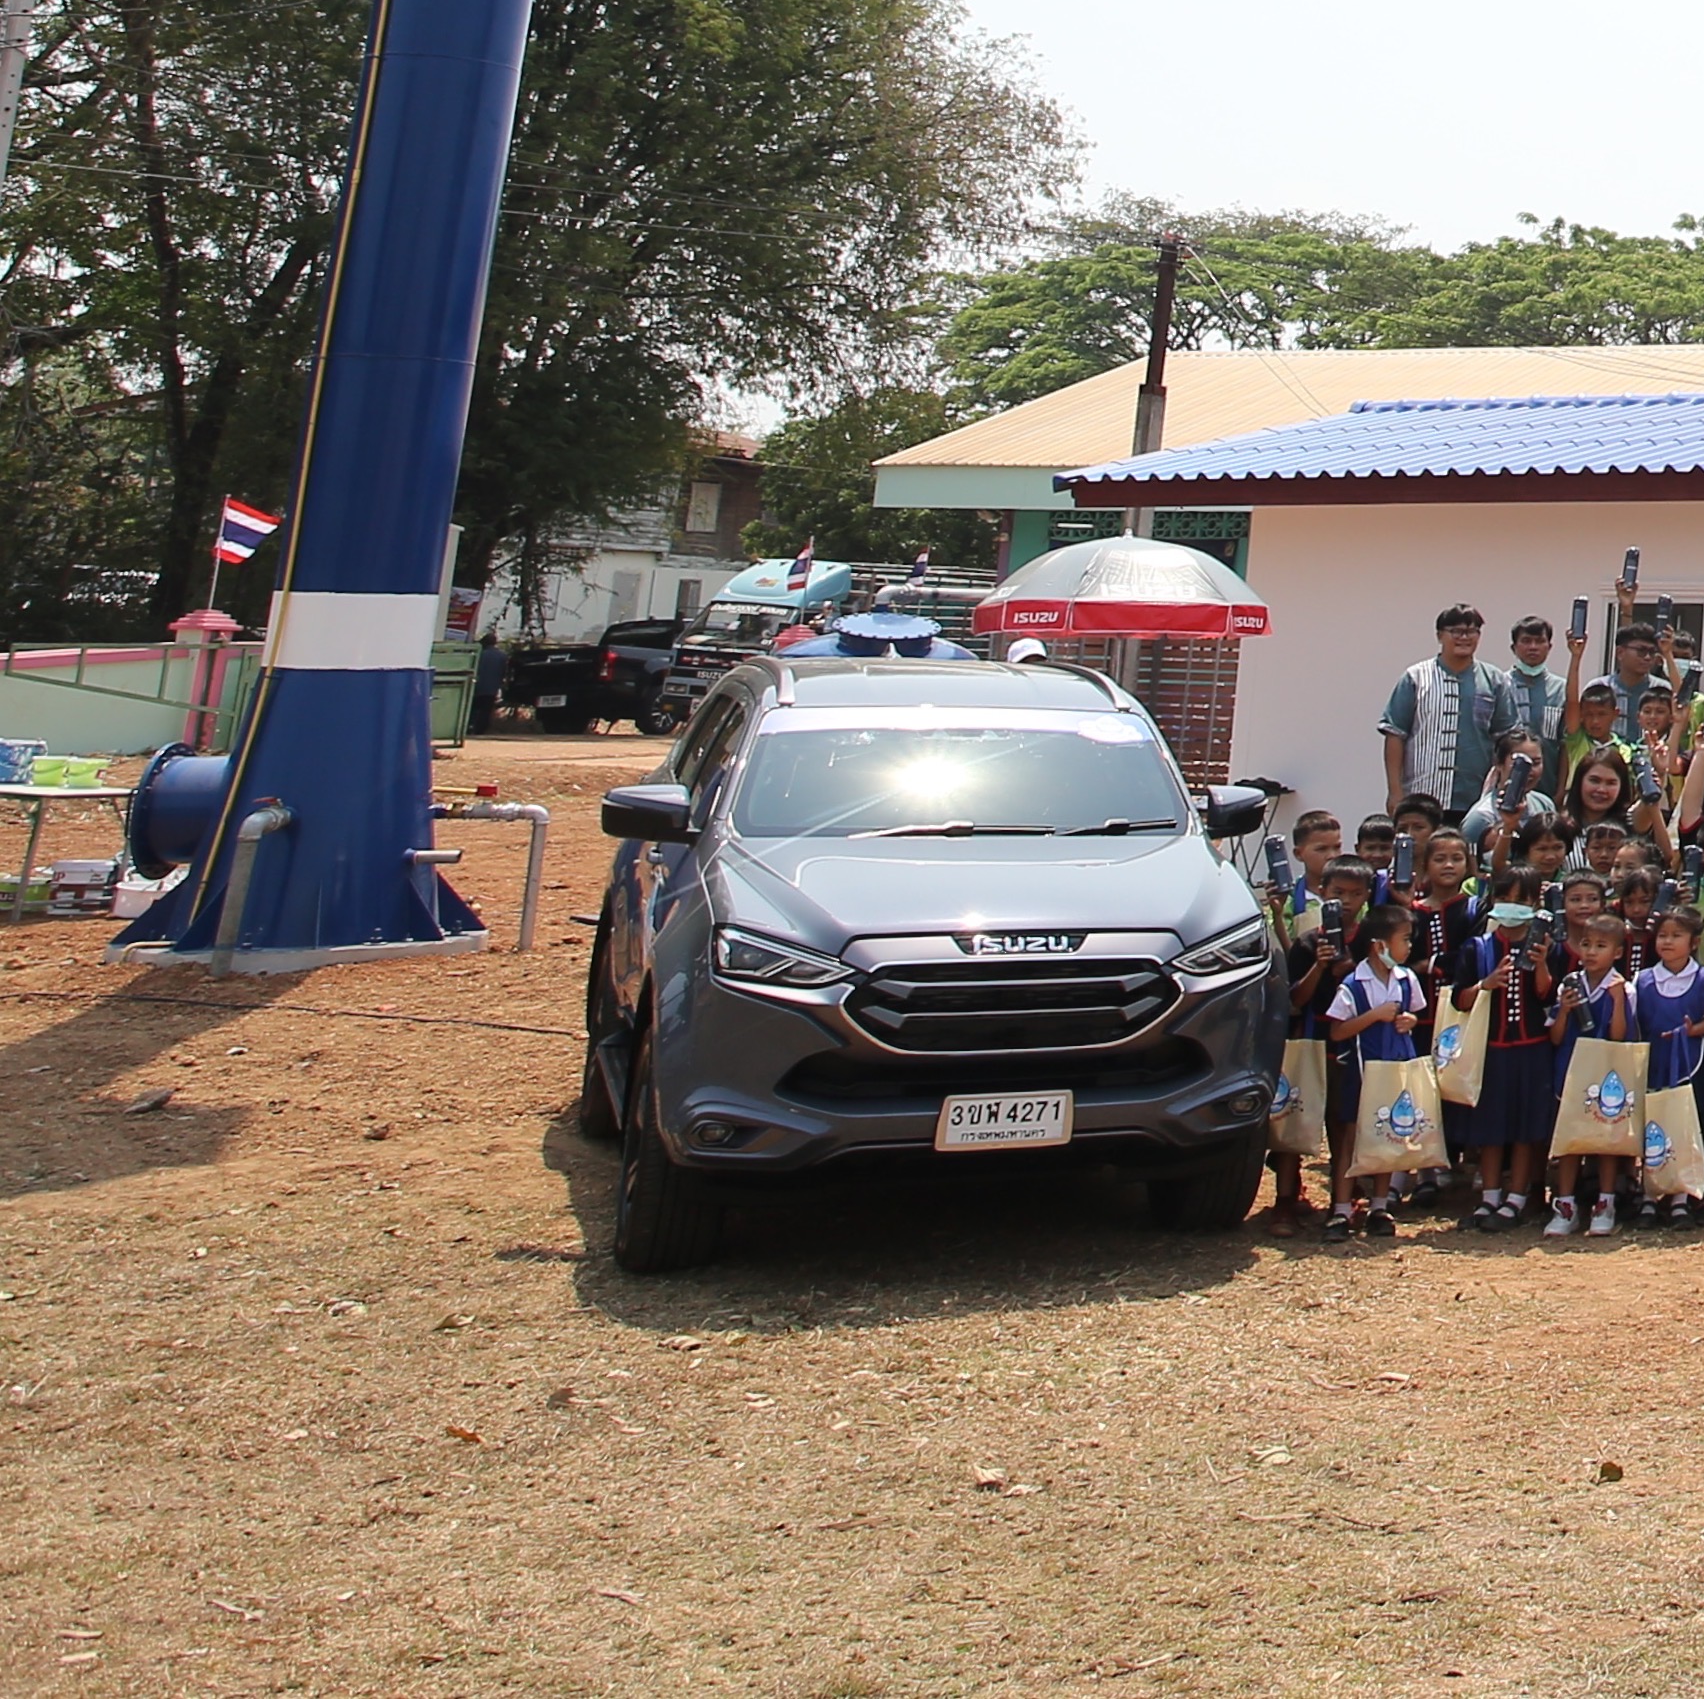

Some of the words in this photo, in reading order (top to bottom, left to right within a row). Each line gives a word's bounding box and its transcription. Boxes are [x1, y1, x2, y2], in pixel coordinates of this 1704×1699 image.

[1012, 611, 1060, 624] ISUZU
[1233, 616, 1264, 629] ISUZU
[972, 934, 1069, 954] ISUZU
[1006, 1100, 1061, 1123] 4271
